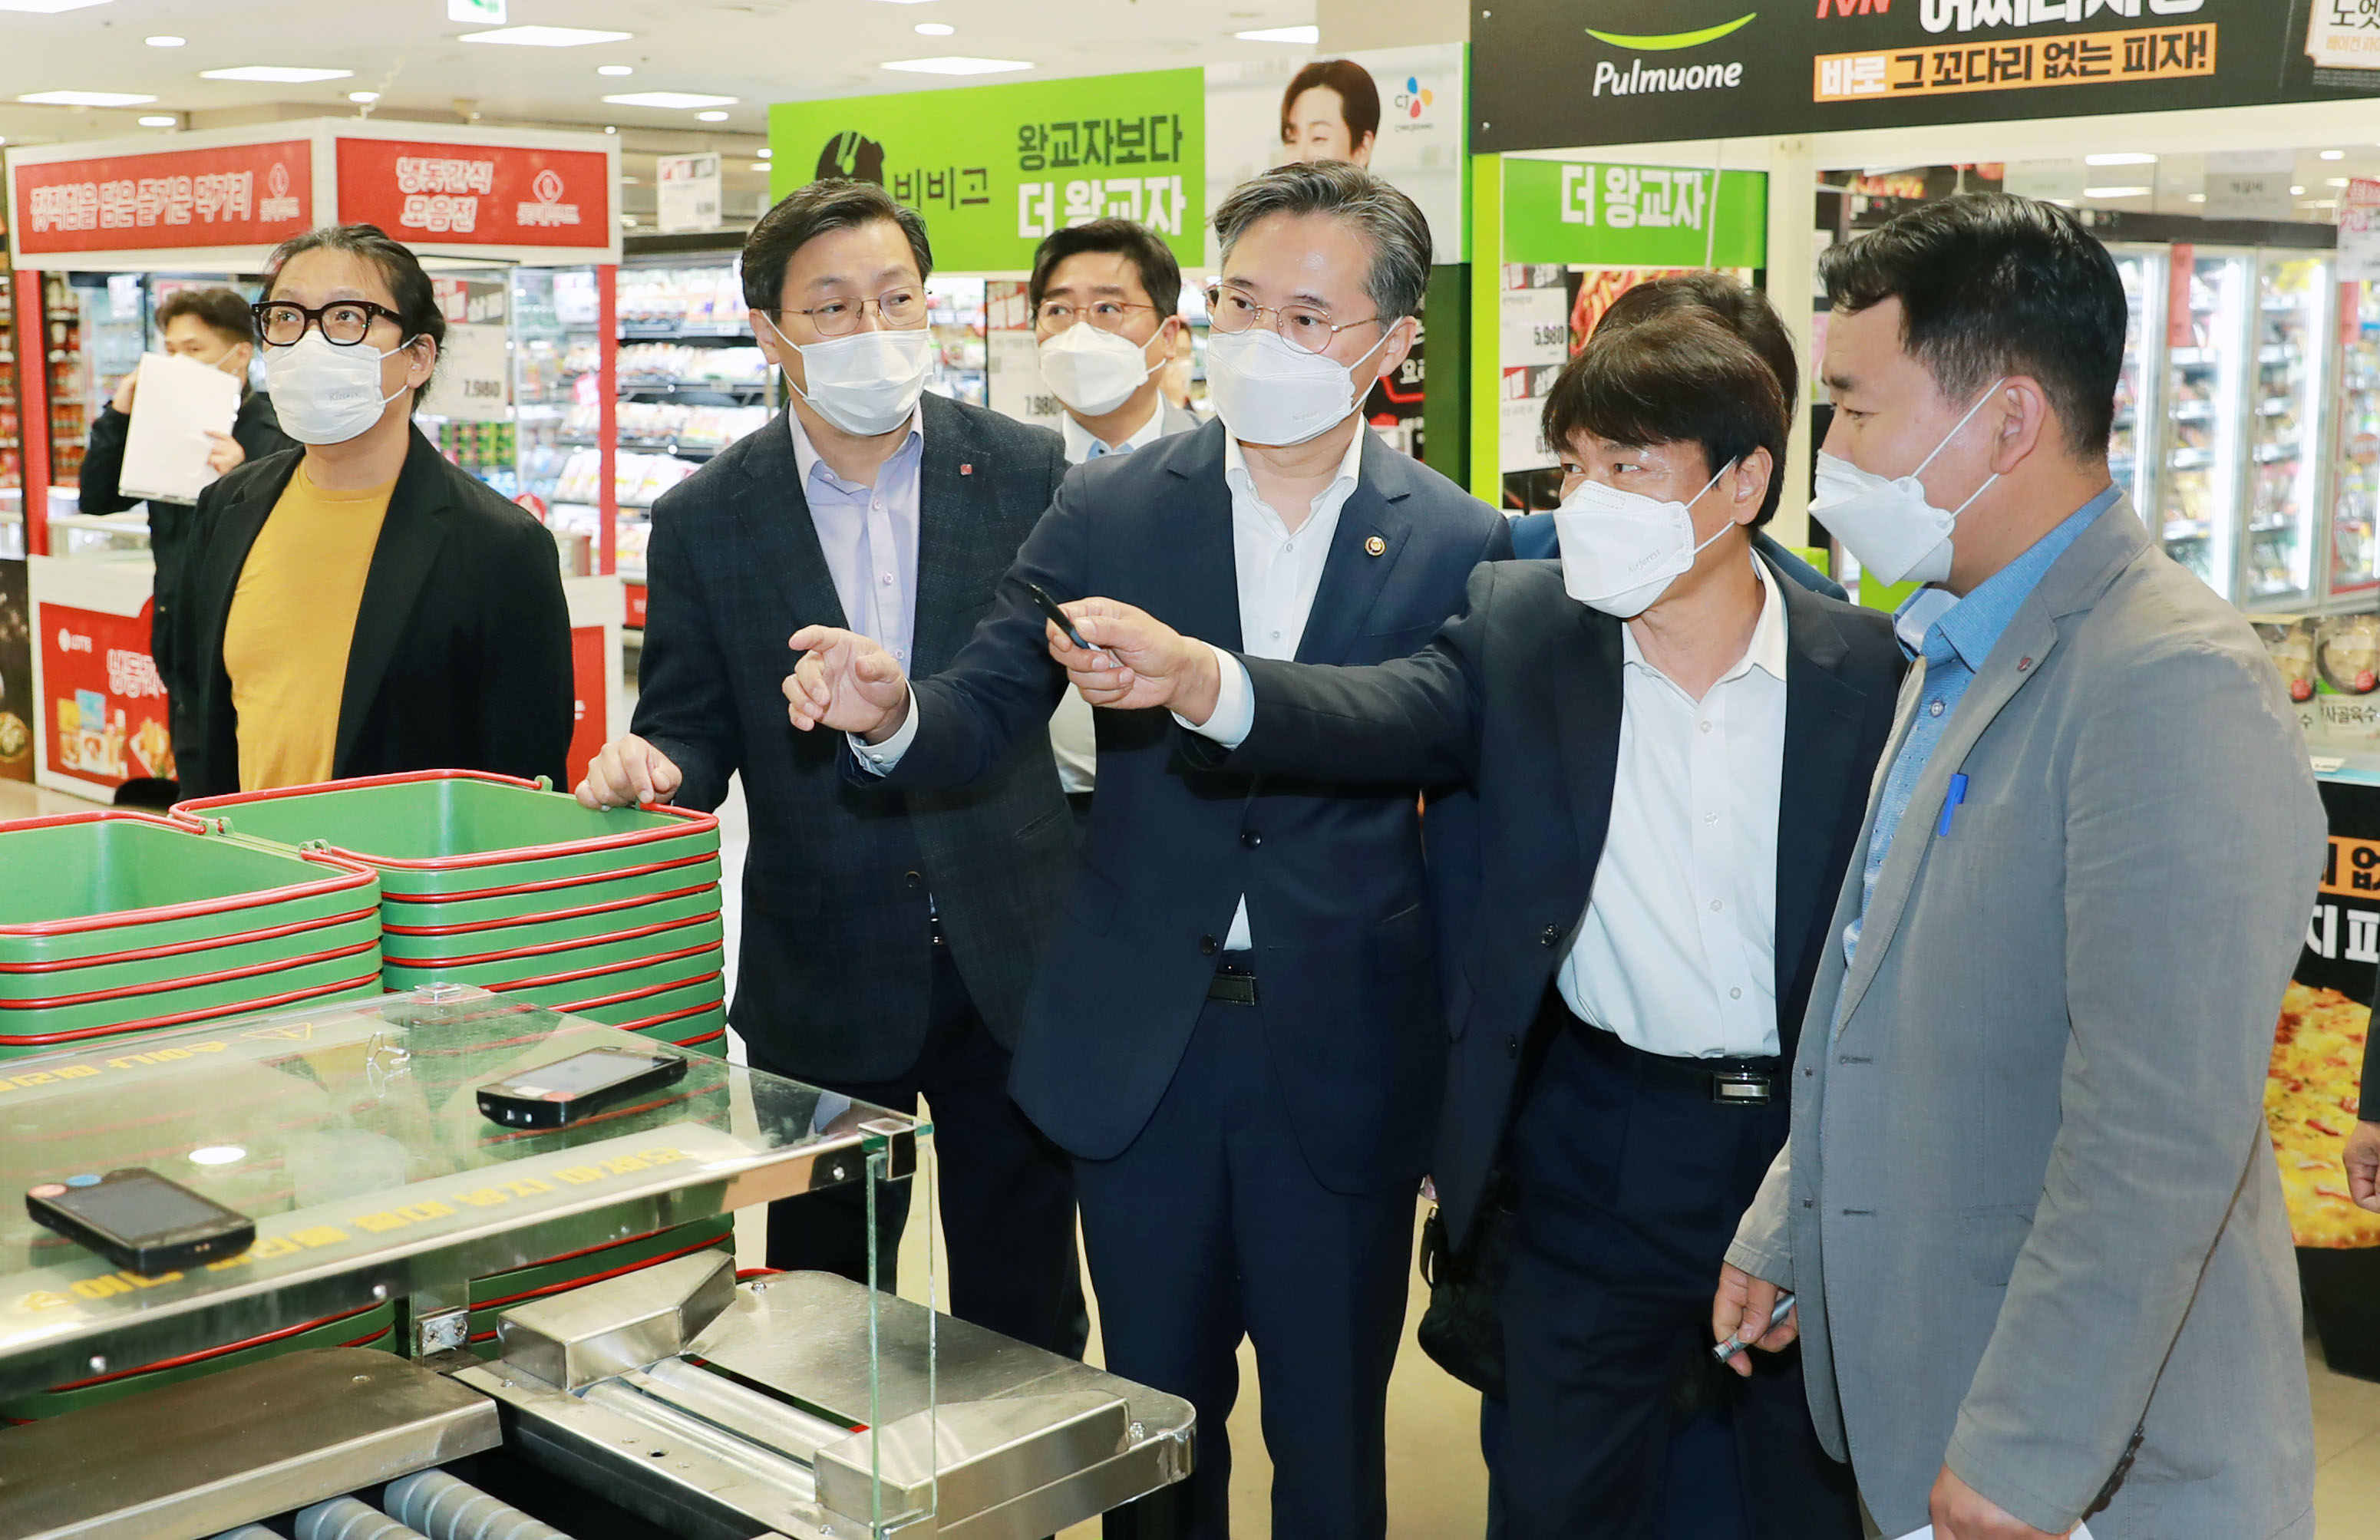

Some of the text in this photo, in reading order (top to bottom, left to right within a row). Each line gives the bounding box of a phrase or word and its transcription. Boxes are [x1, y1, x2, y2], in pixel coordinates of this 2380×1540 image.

[1592, 58, 1744, 97] Pulmuone
[1820, 29, 2208, 97] 바로 그 꼬다리 없는 피자!
[1395, 94, 1409, 110] CJ
[1018, 114, 1183, 172] 왕교자보다
[399, 194, 478, 232] 모음전
[895, 167, 990, 211] 비비고
[1018, 181, 1055, 239] 더
[1561, 164, 1705, 230] 더 왕교자
